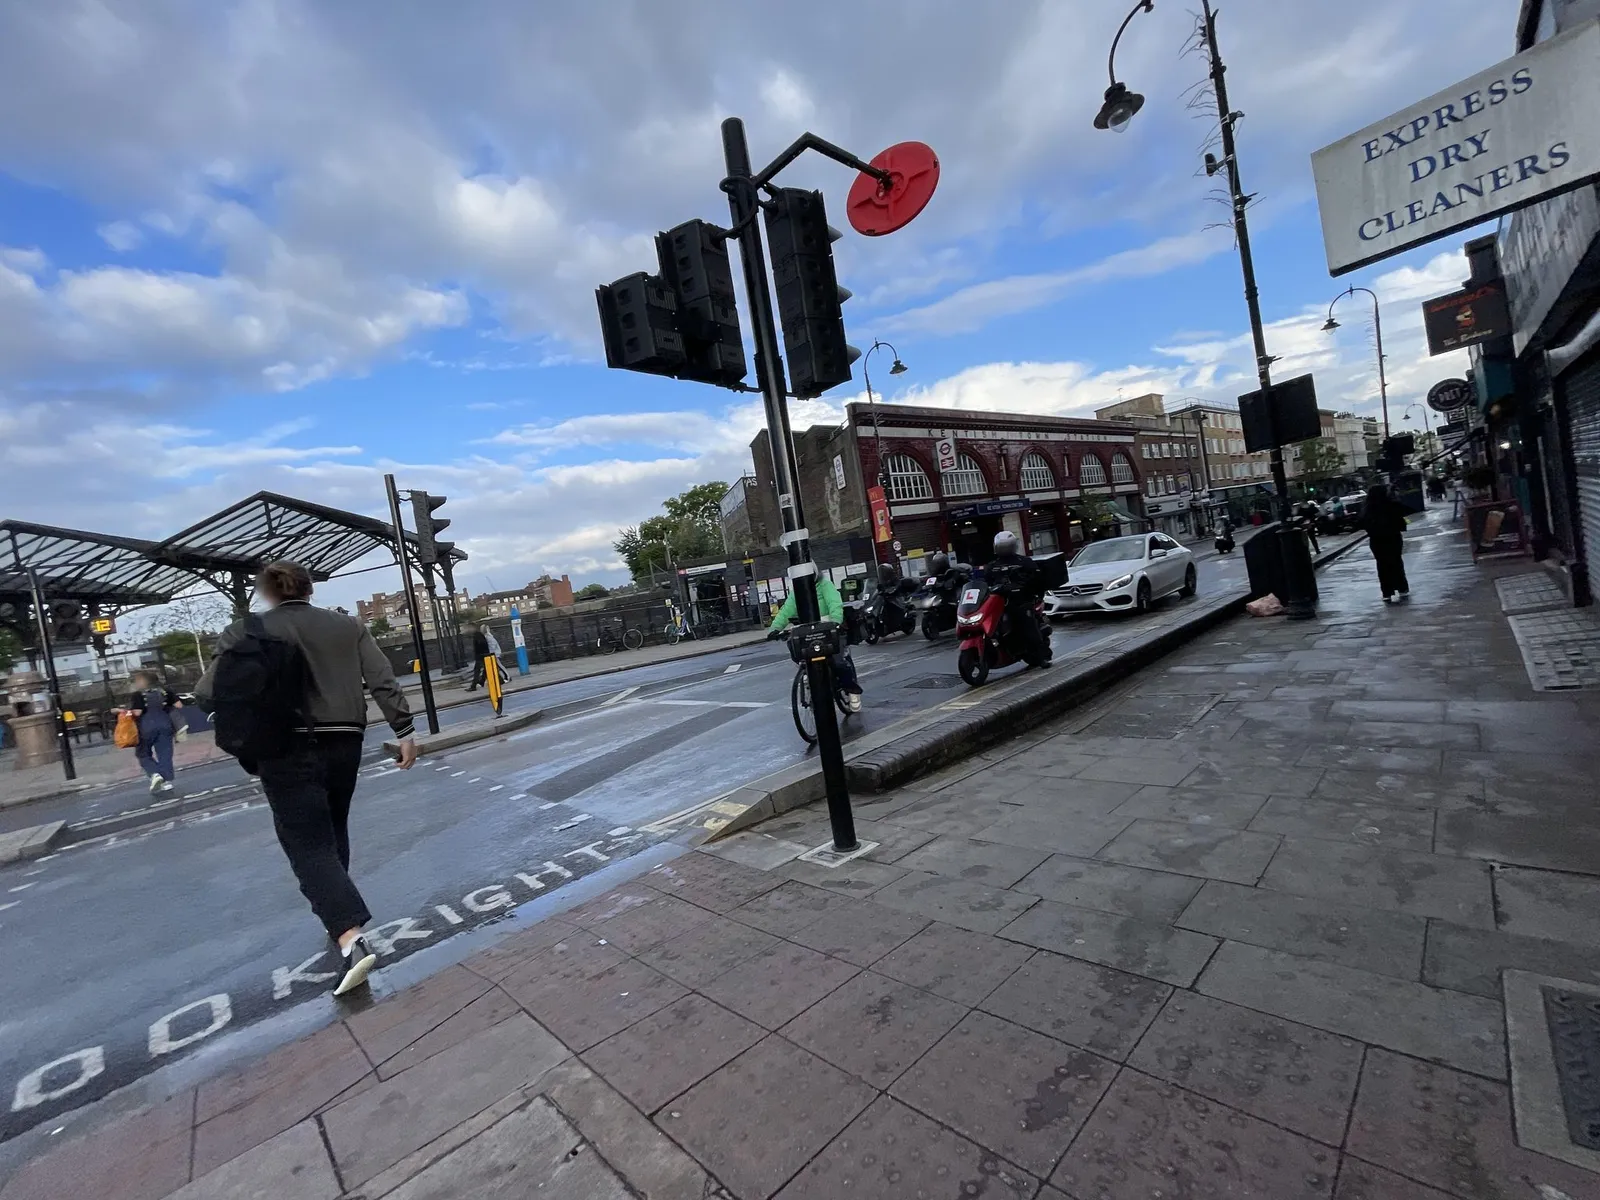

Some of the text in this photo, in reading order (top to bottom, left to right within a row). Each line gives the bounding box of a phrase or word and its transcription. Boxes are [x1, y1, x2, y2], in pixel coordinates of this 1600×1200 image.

[1361, 67, 1534, 164] EXPRESS
[1358, 141, 1571, 242] CLEANERS
[1408, 128, 1492, 184] DRY
[927, 427, 997, 440] KENTISH
[1019, 431, 1050, 441] TOWN
[965, 591, 973, 600] L
[361, 841, 611, 957] RIGHT
